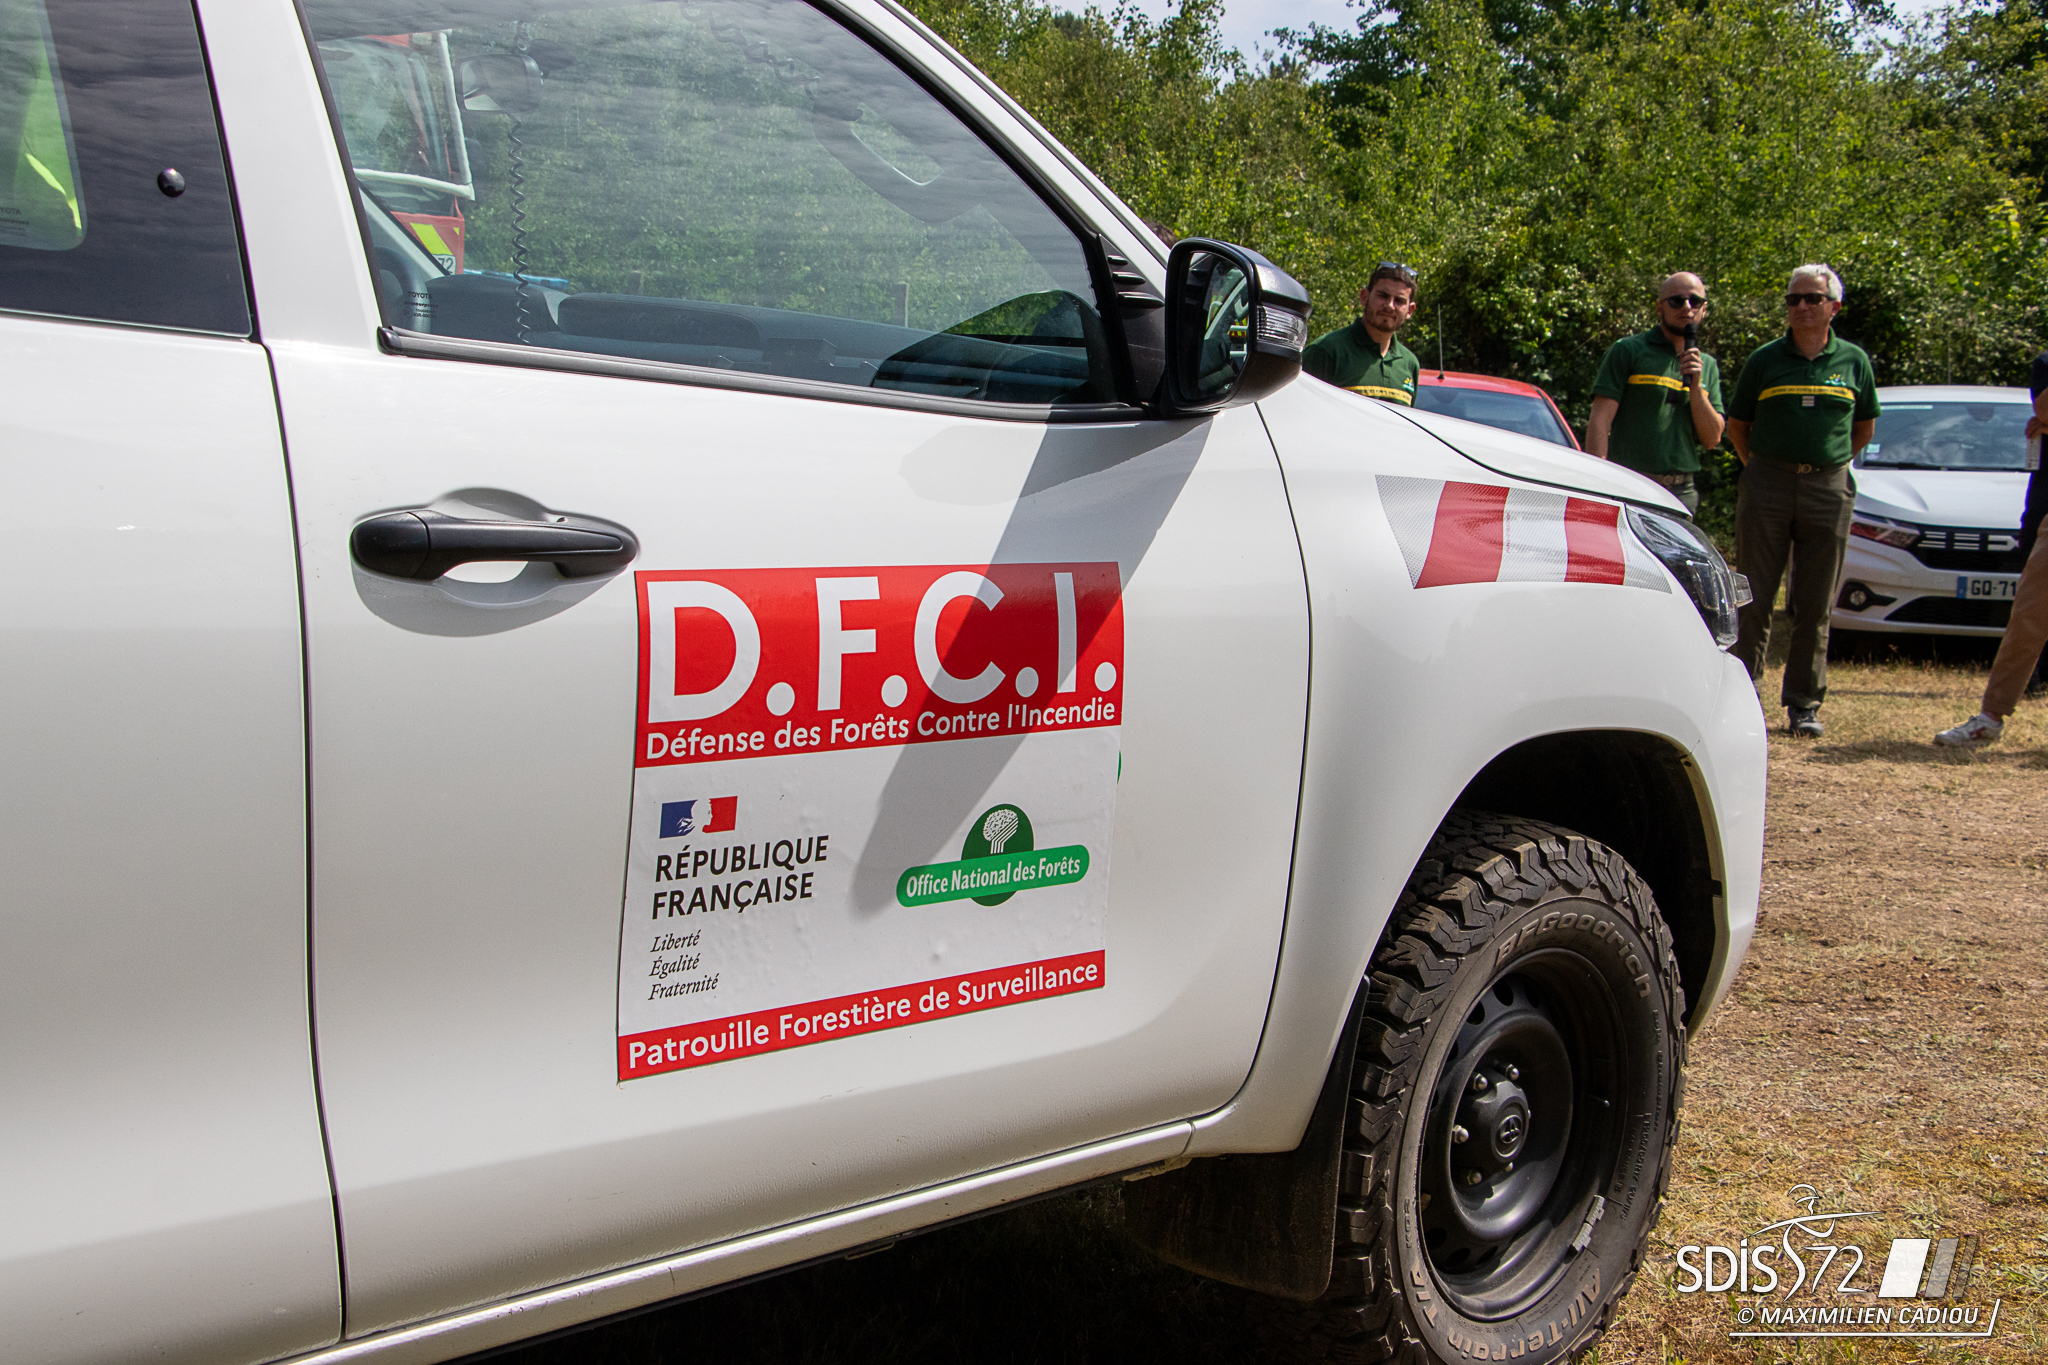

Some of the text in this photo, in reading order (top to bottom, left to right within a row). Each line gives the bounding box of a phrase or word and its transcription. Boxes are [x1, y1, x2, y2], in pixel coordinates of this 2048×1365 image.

[407, 290, 432, 299] TOYOTA
[646, 571, 1117, 724] D.F.C.I.
[646, 696, 1116, 760] Défense des Forêts Contre l'Incendie
[655, 835, 829, 883] RÉPUBLIQUE
[906, 857, 1081, 898] Office National des Forêts
[652, 872, 814, 920] FRANÇAISE
[650, 929, 702, 953] Liberté
[1494, 911, 1651, 999] BFGoodrich
[648, 953, 701, 980] Égalité
[648, 973, 720, 1001] Fraternité
[628, 962, 1099, 1069] Patrouille Forestière de Surveillance
[1448, 1268, 1600, 1362] All-Terrain
